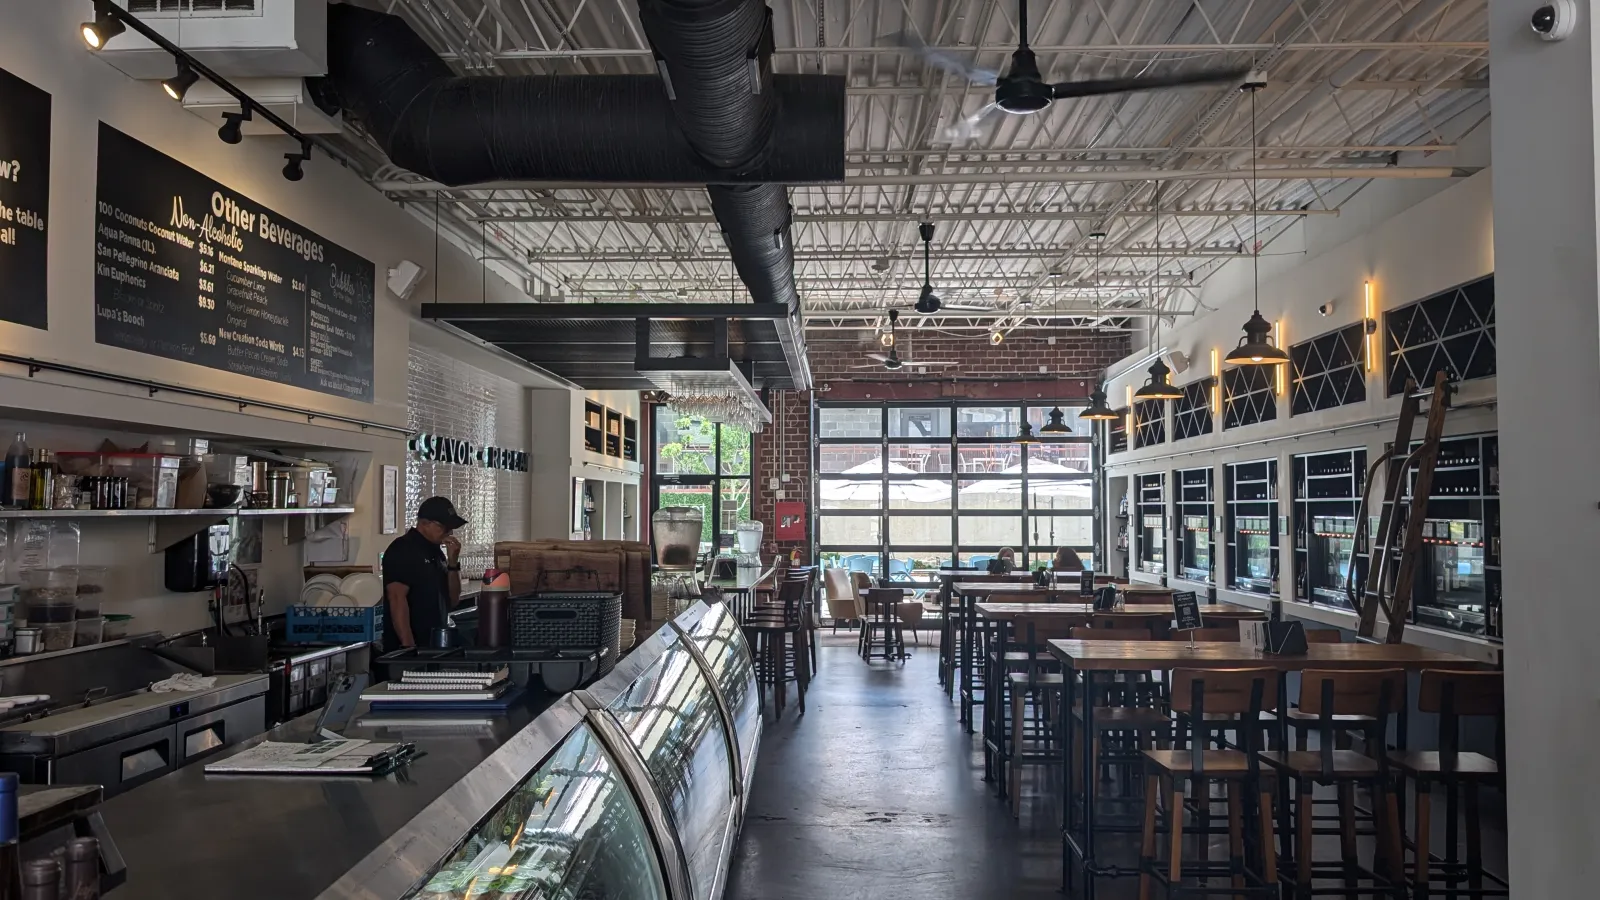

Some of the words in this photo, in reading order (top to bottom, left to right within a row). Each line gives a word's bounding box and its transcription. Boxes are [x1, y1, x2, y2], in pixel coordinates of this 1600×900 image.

[16, 207, 44, 231] table
[98, 200, 113, 217] 100
[114, 207, 148, 231] Coconuts
[148, 221, 176, 242] Coconut
[175, 232, 195, 249] Water
[170, 195, 244, 253] Non-Alcoholic
[212, 191, 256, 232] Other
[259, 213, 324, 262] Beverages
[97, 222, 118, 240] Aqua
[119, 229, 141, 249] Panna
[199, 259, 215, 275] $6.21
[97, 242, 112, 258] San
[113, 247, 148, 271] Pellegrino
[149, 261, 180, 281] Aranciata
[198, 278, 214, 293] $3.61
[243, 261, 267, 280] Sparkling
[267, 270, 283, 285] Water
[97, 262, 110, 277] Kin
[110, 266, 147, 289] Euphorics
[198, 294, 215, 310] $9.30
[225, 270, 253, 288] Cucumber
[253, 281, 266, 293] Lime
[226, 284, 253, 301] Grapefruit
[253, 292, 268, 306] Peach
[96, 303, 121, 322] Lupa's
[122, 310, 145, 328] Booch
[242, 304, 260, 318] Lemon
[218, 327, 232, 341] New
[231, 331, 255, 345] Creation
[255, 336, 269, 349] Soda
[268, 340, 285, 354] Works
[227, 344, 244, 357] Butter
[430, 434, 474, 465] SAVOR
